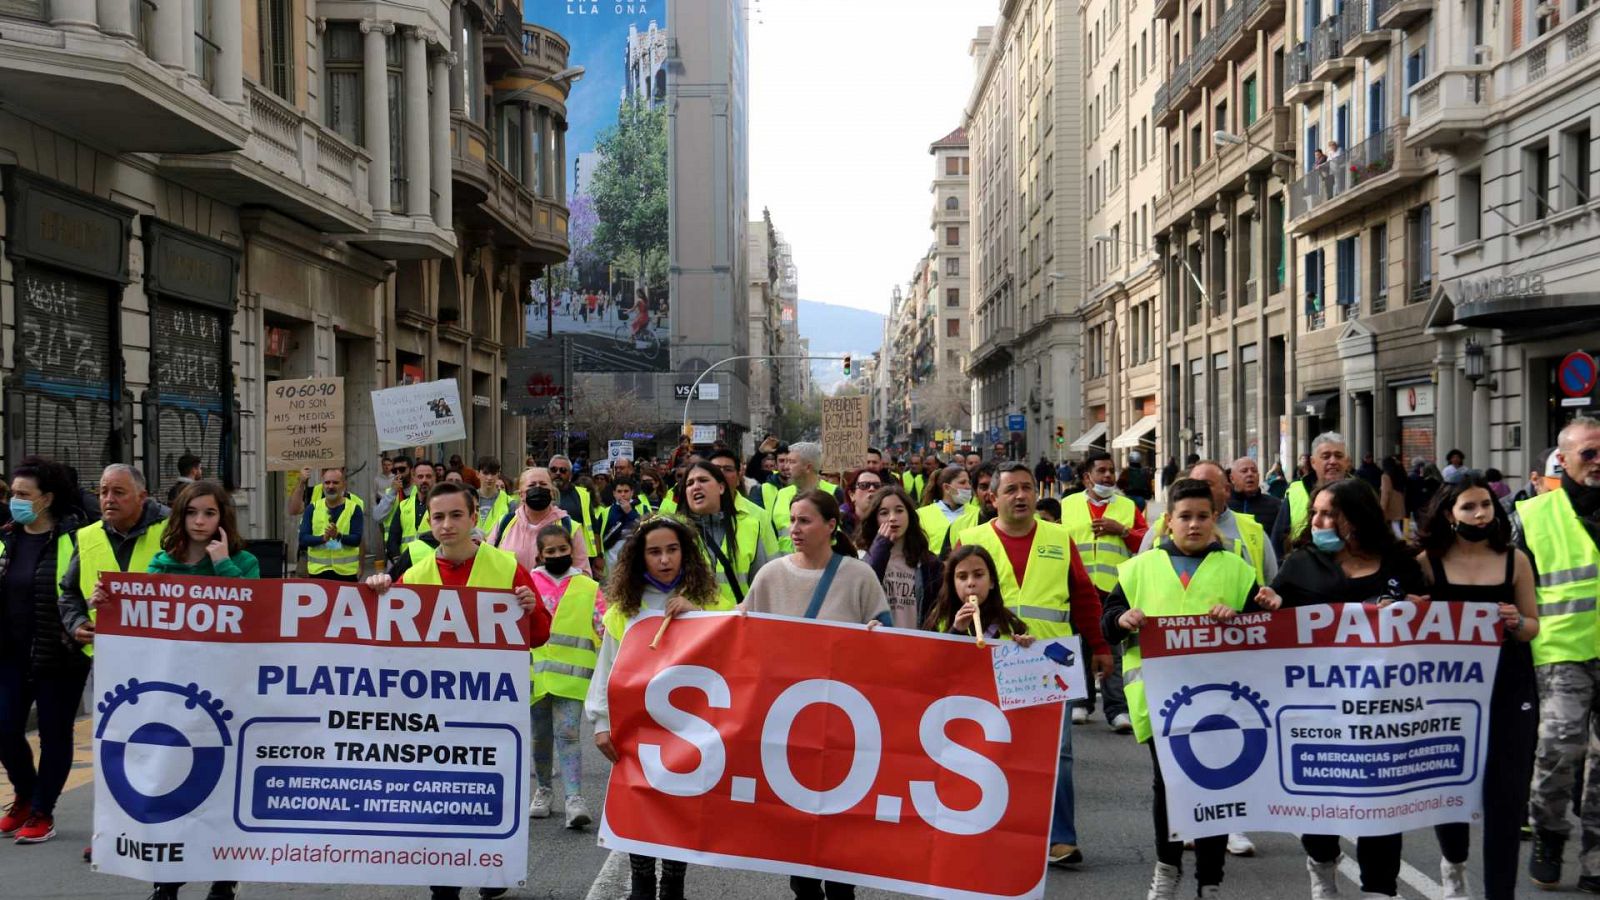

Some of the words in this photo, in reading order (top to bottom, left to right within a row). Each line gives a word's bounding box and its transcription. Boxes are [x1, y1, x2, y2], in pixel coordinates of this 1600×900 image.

[567, 5, 598, 14] LLA
[615, 5, 647, 14] ONA
[289, 400, 305, 409] NO
[309, 399, 326, 408] SON
[274, 413, 290, 422] MIS
[299, 411, 335, 420] MEDIDAS
[287, 425, 306, 435] SON
[311, 423, 327, 432] MIS
[293, 437, 322, 447] HORAS
[281, 447, 334, 458] SEMANALES
[111, 581, 156, 597] PARA
[160, 583, 184, 597] NO
[189, 584, 253, 601] GANAR
[120, 600, 243, 633] MEJOR
[280, 583, 526, 645] PARAR
[1158, 616, 1196, 627] PARA
[1296, 600, 1500, 644] PARAR
[1165, 625, 1267, 650] MEJOR
[257, 665, 518, 702] PLATAFORMA
[1285, 661, 1484, 688] PLATAFORMA
[1342, 697, 1423, 715] DEFENSA
[328, 710, 440, 732] DEFENSA
[1290, 727, 1342, 739] SECTOR
[1348, 717, 1462, 740] TRANSPORTE
[256, 745, 325, 760] SECTOR
[334, 742, 497, 766] TRANSPORTE
[638, 664, 1012, 835] S.O.S
[1300, 752, 1314, 761] de
[1317, 752, 1390, 763] MERCANCIAS
[1392, 752, 1408, 764] por
[1408, 744, 1460, 758] CARRETERA
[1303, 767, 1368, 779] NACIONAL
[1378, 758, 1457, 778] INTERNACIONAL
[266, 777, 285, 789] de
[288, 777, 382, 792] MERCANCIAS
[385, 781, 409, 795] por
[412, 781, 496, 795] CARRETERA
[267, 796, 350, 811] NACIONAL
[363, 800, 493, 816] INTERNACIONAL
[1194, 802, 1247, 822] ÚNETE
[116, 834, 184, 862] ÚNETE
[212, 843, 504, 869] www.plataformanacional.es
